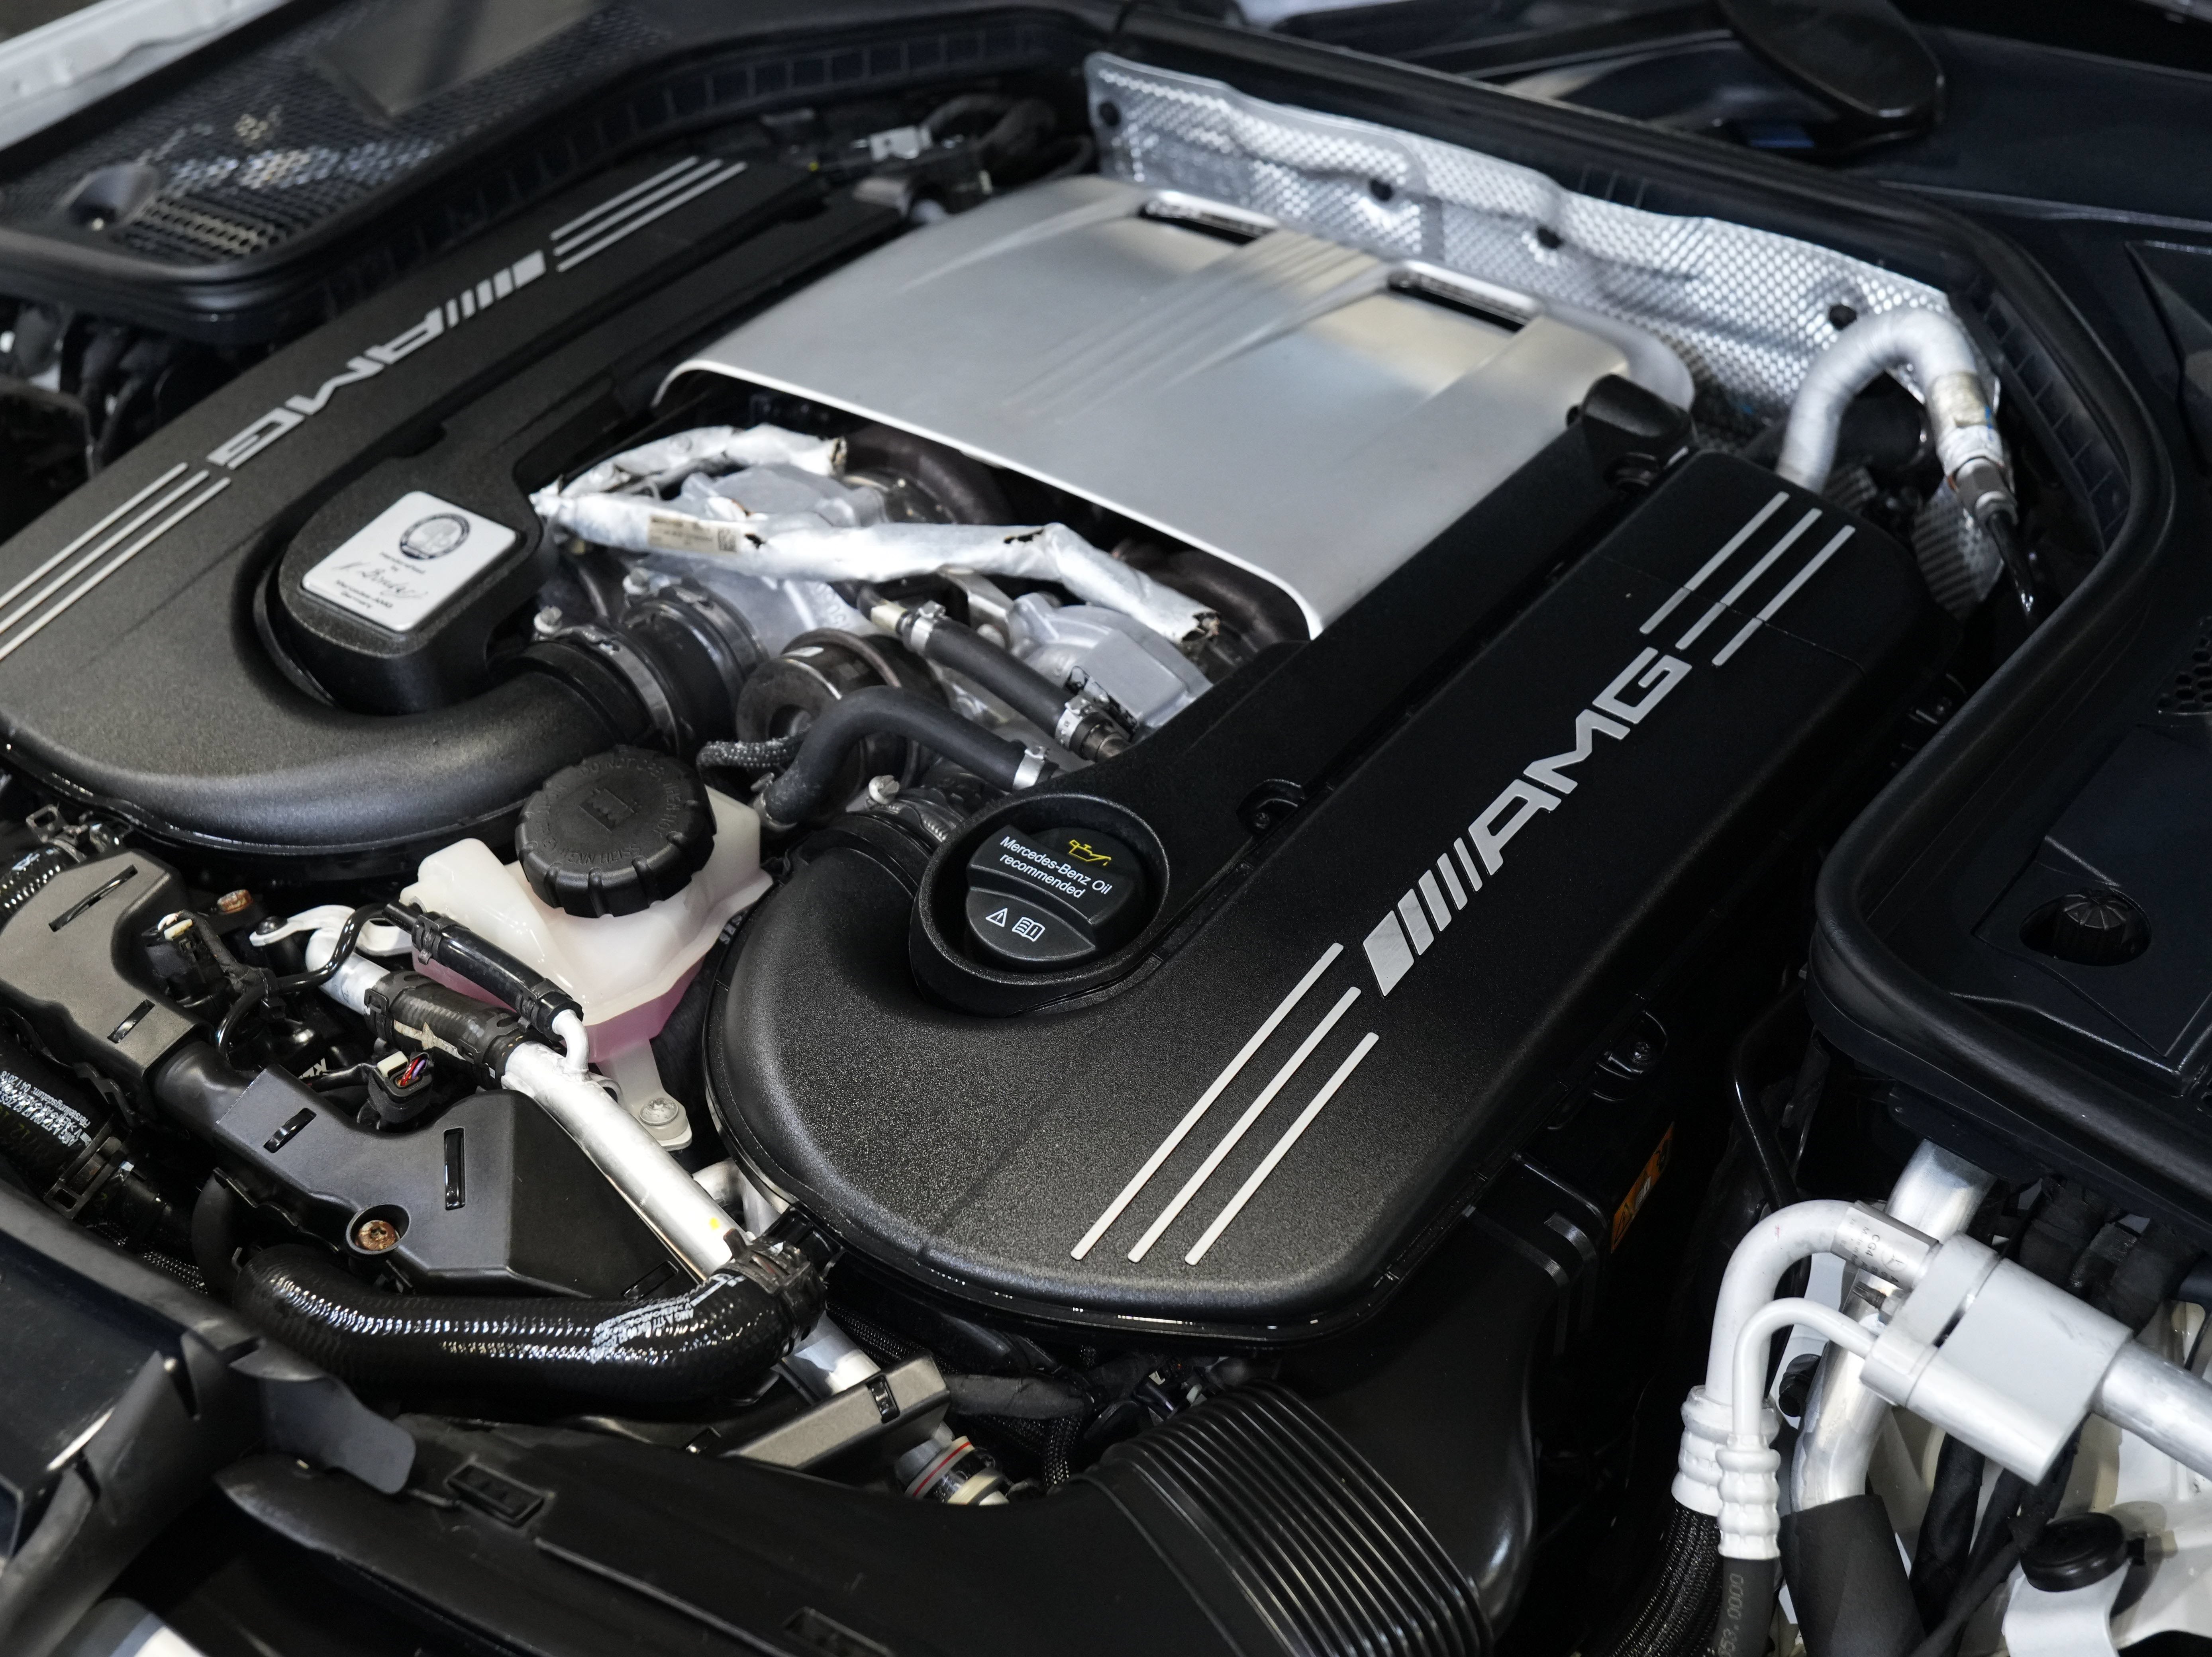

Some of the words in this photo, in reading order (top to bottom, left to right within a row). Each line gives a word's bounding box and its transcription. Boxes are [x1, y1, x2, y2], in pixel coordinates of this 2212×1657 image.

[206, 307, 444, 469] AMG
[1468, 647, 1692, 875] AMG
[999, 853, 1086, 899] recommended
[1000, 836, 1091, 886] Mercedes-Benz
[1092, 879, 1113, 895] Oil
[1865, 1234, 1881, 1257] CG4
